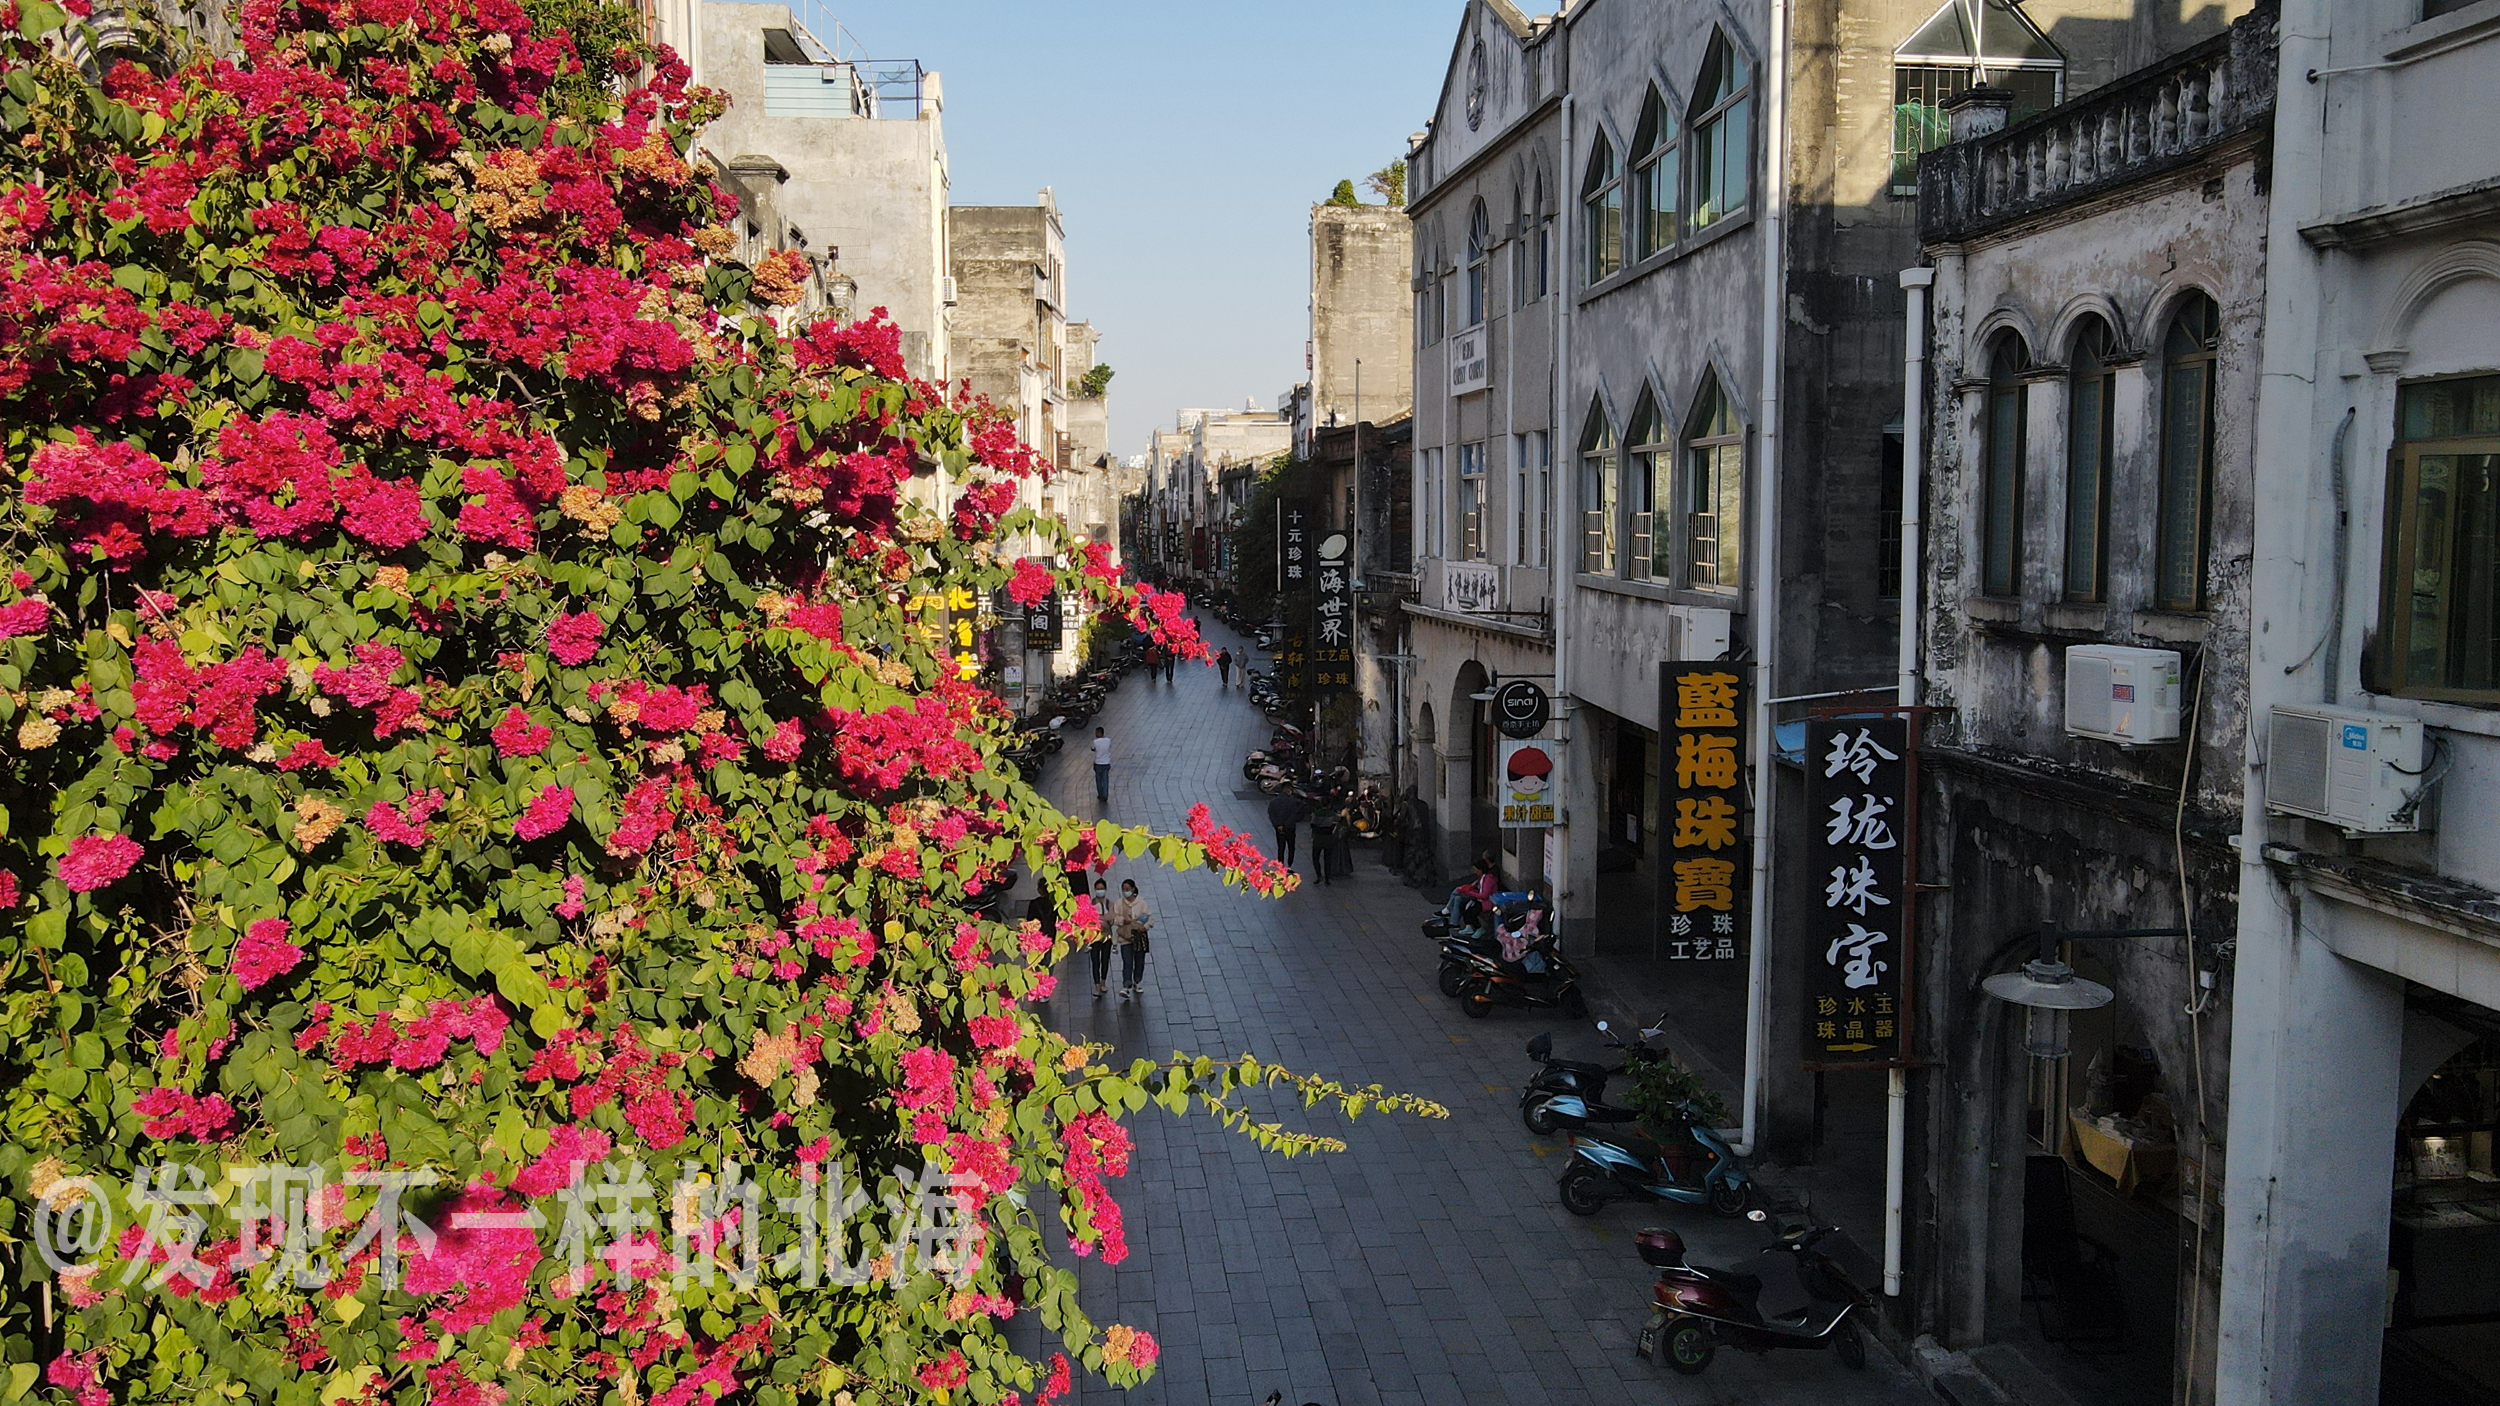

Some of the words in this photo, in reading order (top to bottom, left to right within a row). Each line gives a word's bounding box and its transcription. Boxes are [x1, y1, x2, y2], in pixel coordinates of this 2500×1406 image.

[1288, 510, 1302, 579] 十元珍珠
[1317, 569, 1348, 647] 海世界
[1315, 648, 1350, 662] 工艺品
[1317, 672, 1349, 686] 珍珠
[1507, 698, 1534, 707] sinai
[1672, 671, 1740, 913] 藍梅珠寶
[1502, 804, 1554, 822] 果汁甜品
[1825, 728, 1899, 989] 玲珑珠宝
[1670, 914, 1734, 936] 珍珠
[1670, 937, 1735, 961] 工艺品
